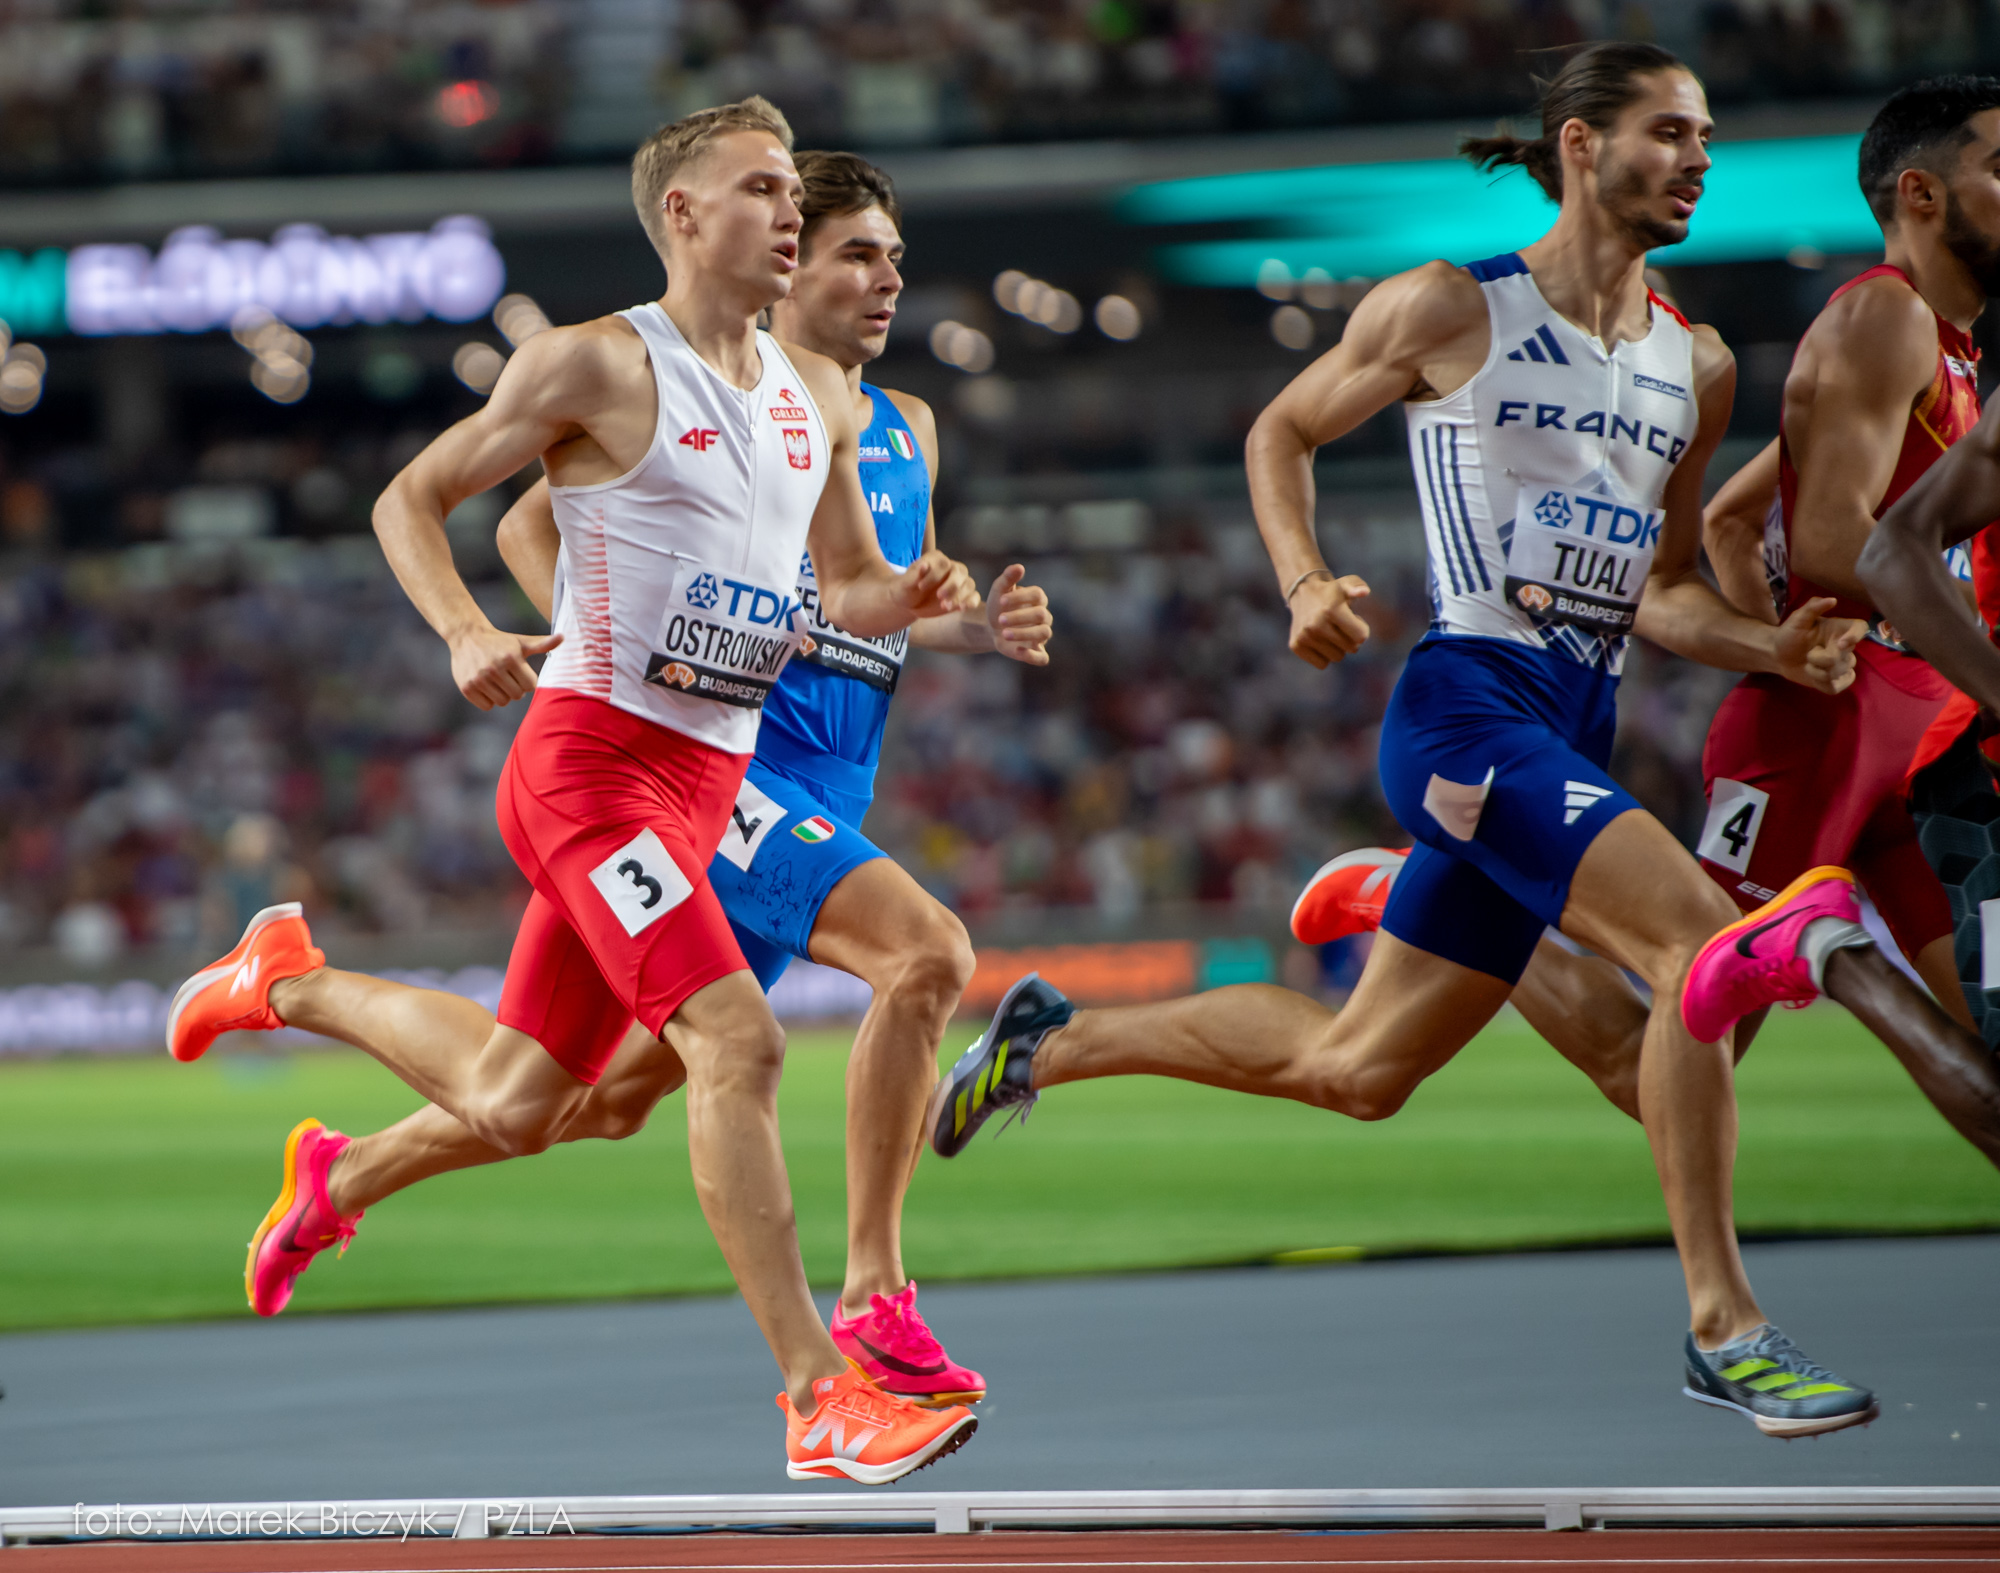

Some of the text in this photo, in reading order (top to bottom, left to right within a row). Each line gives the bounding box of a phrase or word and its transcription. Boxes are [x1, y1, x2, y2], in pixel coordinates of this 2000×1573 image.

[678, 427, 720, 451] 4F
[772, 408, 806, 419] ORLEN
[1575, 496, 1663, 549] TDK
[1554, 541, 1631, 596] TUAL
[722, 578, 803, 633] TDK
[665, 613, 790, 676] OSTROWSKI
[1721, 802, 1756, 857] 4
[617, 858, 662, 910] 3
